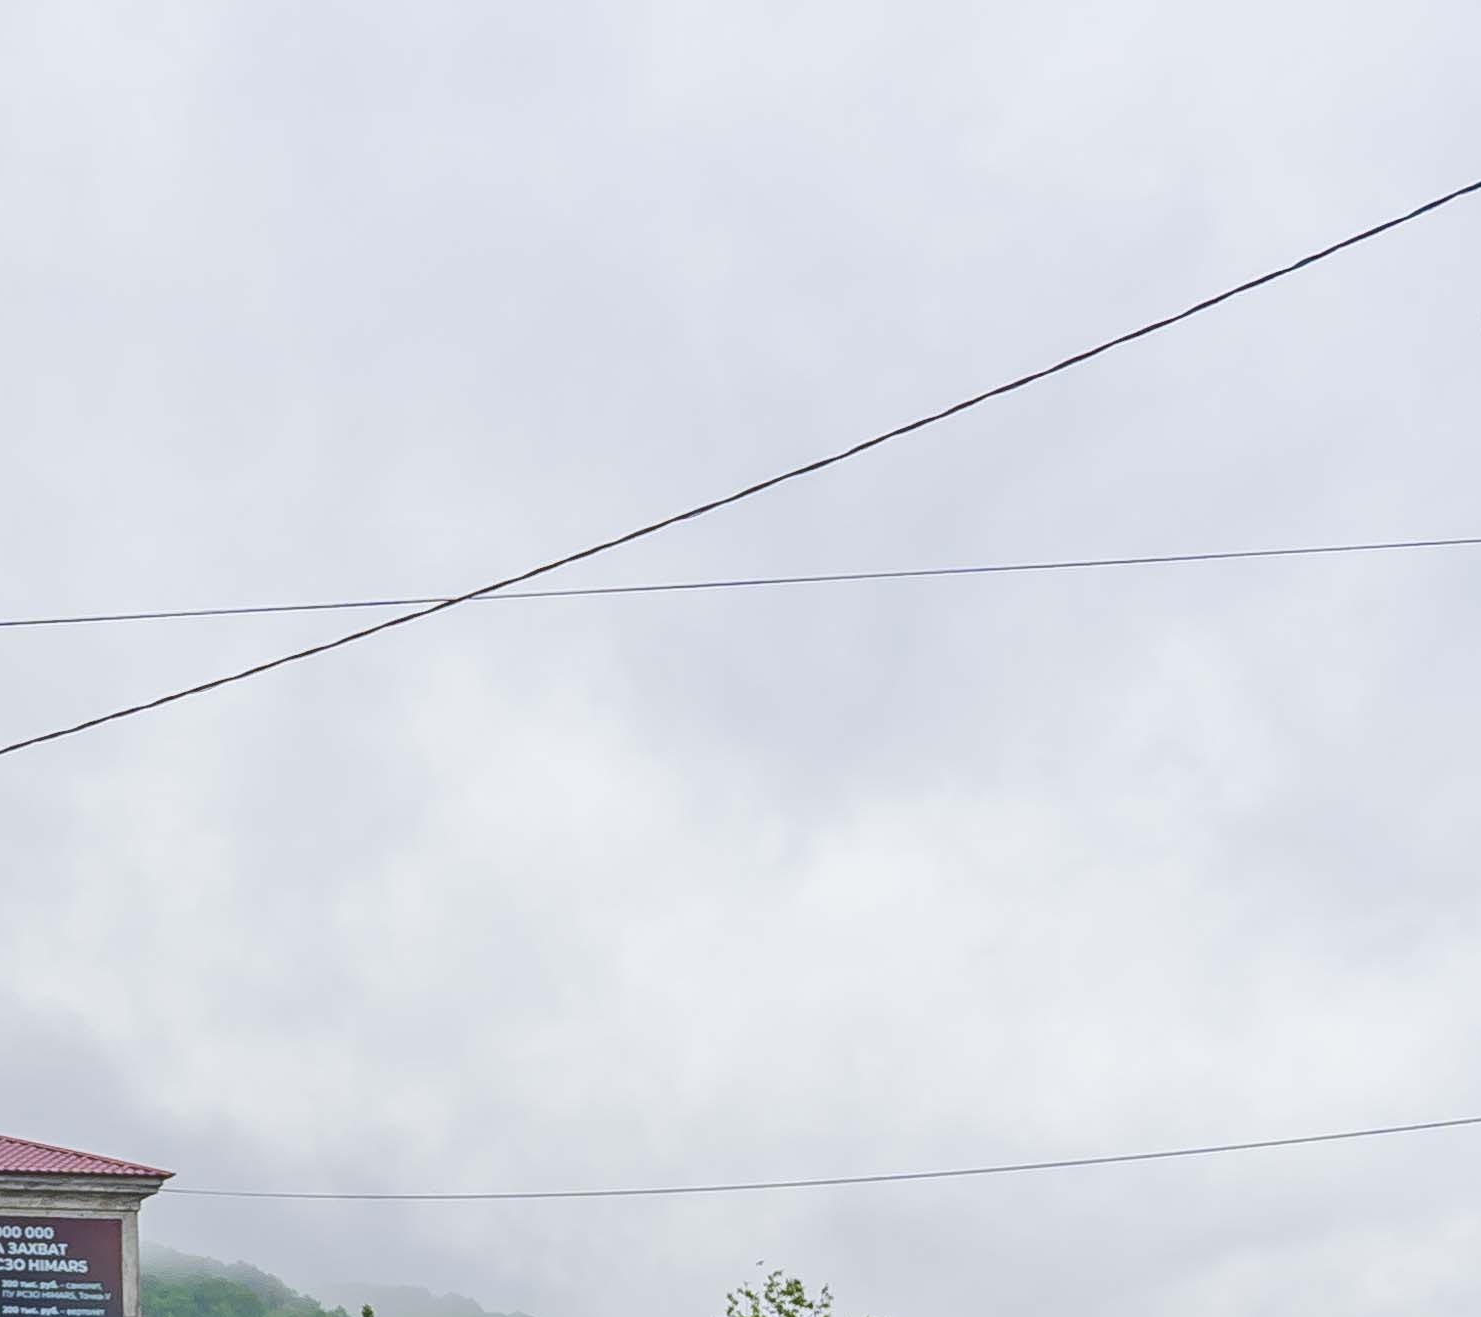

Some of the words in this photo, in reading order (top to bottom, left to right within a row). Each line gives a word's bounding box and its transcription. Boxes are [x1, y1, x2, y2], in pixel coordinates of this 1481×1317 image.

[25, 1226, 54, 1239] 000
[7, 1243, 68, 1255] ЗАХВАТ
[28, 1260, 88, 1273] HIMARS
